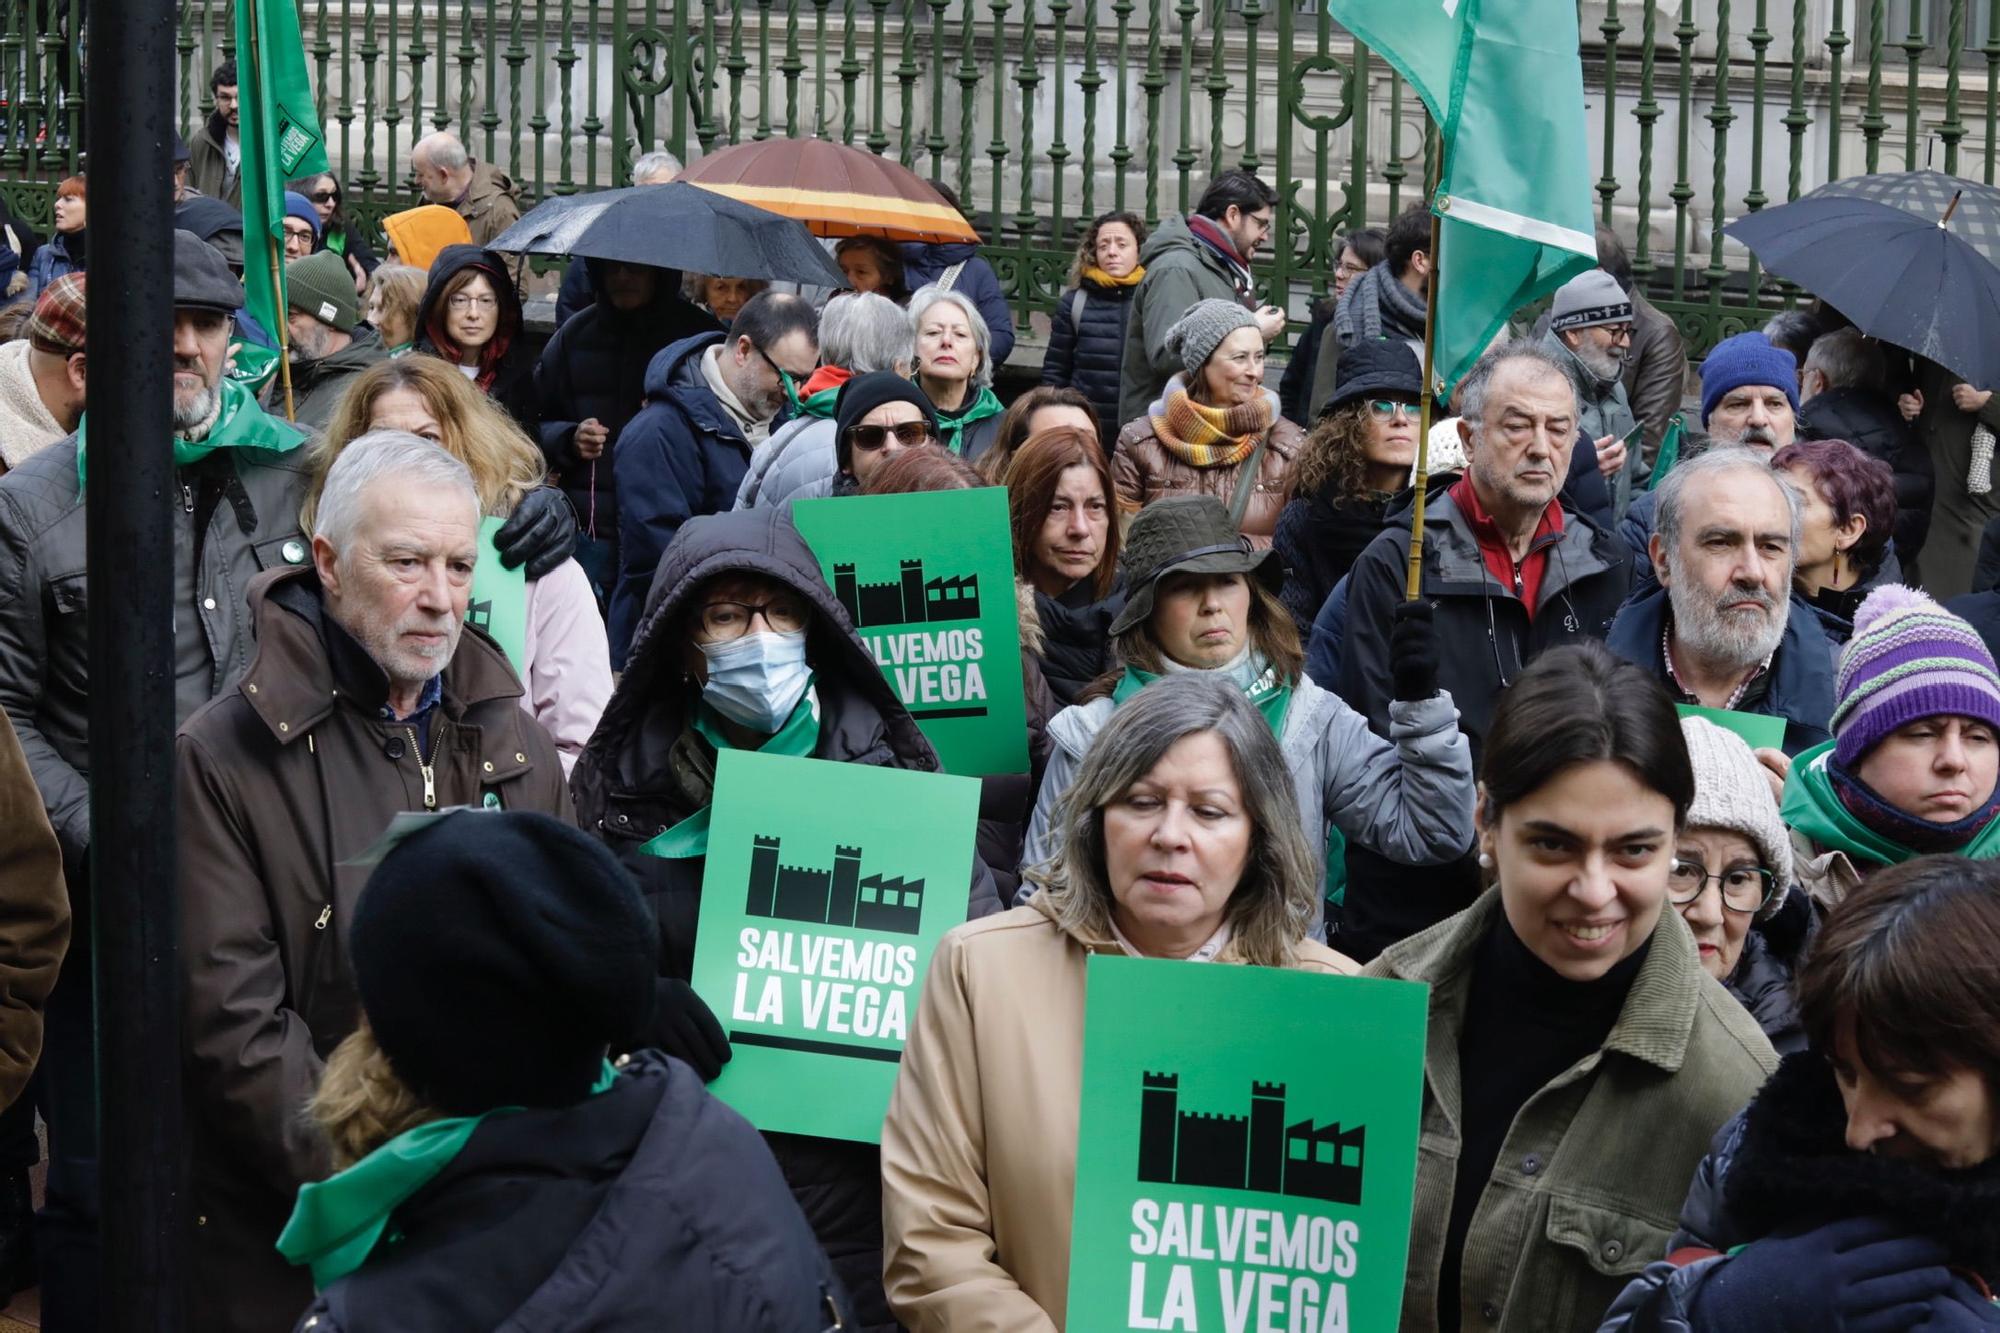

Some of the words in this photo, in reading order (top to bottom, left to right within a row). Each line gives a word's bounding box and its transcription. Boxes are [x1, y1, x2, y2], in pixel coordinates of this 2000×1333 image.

[861, 628, 983, 666] LVEMOS
[894, 662, 987, 704] VEGA
[737, 927, 917, 987] SALVEMOS
[732, 972, 784, 1025] LA
[801, 979, 907, 1040] VEGA
[1130, 1198, 1359, 1278] SALVEMOS
[1128, 1261, 1198, 1332] LA
[1218, 1268, 1349, 1333] VEGA
